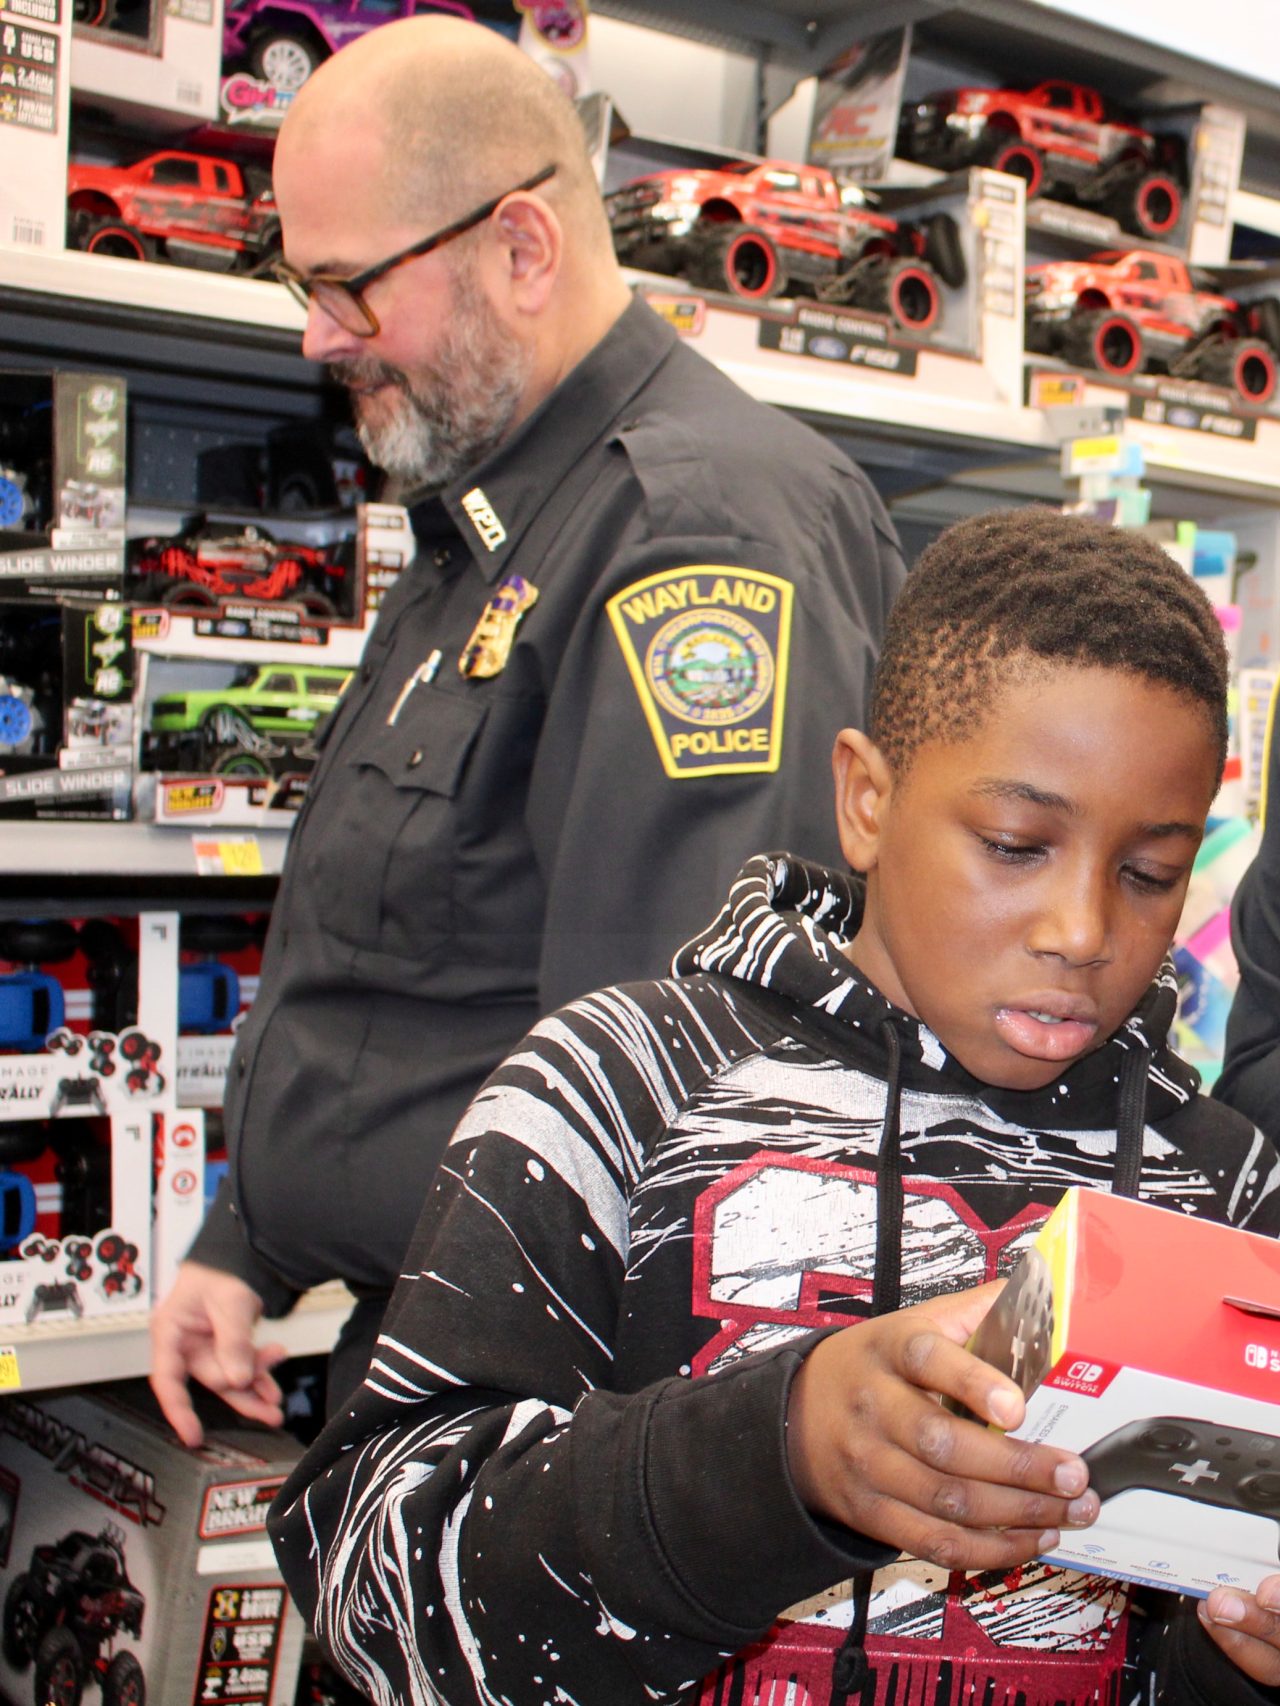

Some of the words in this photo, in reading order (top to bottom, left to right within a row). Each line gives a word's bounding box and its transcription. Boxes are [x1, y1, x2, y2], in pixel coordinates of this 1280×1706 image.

[21, 42, 54, 64] USB
[51, 554, 118, 573] WINDER
[621, 578, 777, 624] WAYLAND
[671, 727, 771, 758] POLICE
[5, 775, 54, 798] SLIDE
[60, 769, 126, 792] WINDER
[1053, 1378, 1099, 1394] SWITCH
[1100, 1570, 1180, 1593] WIRELESS
